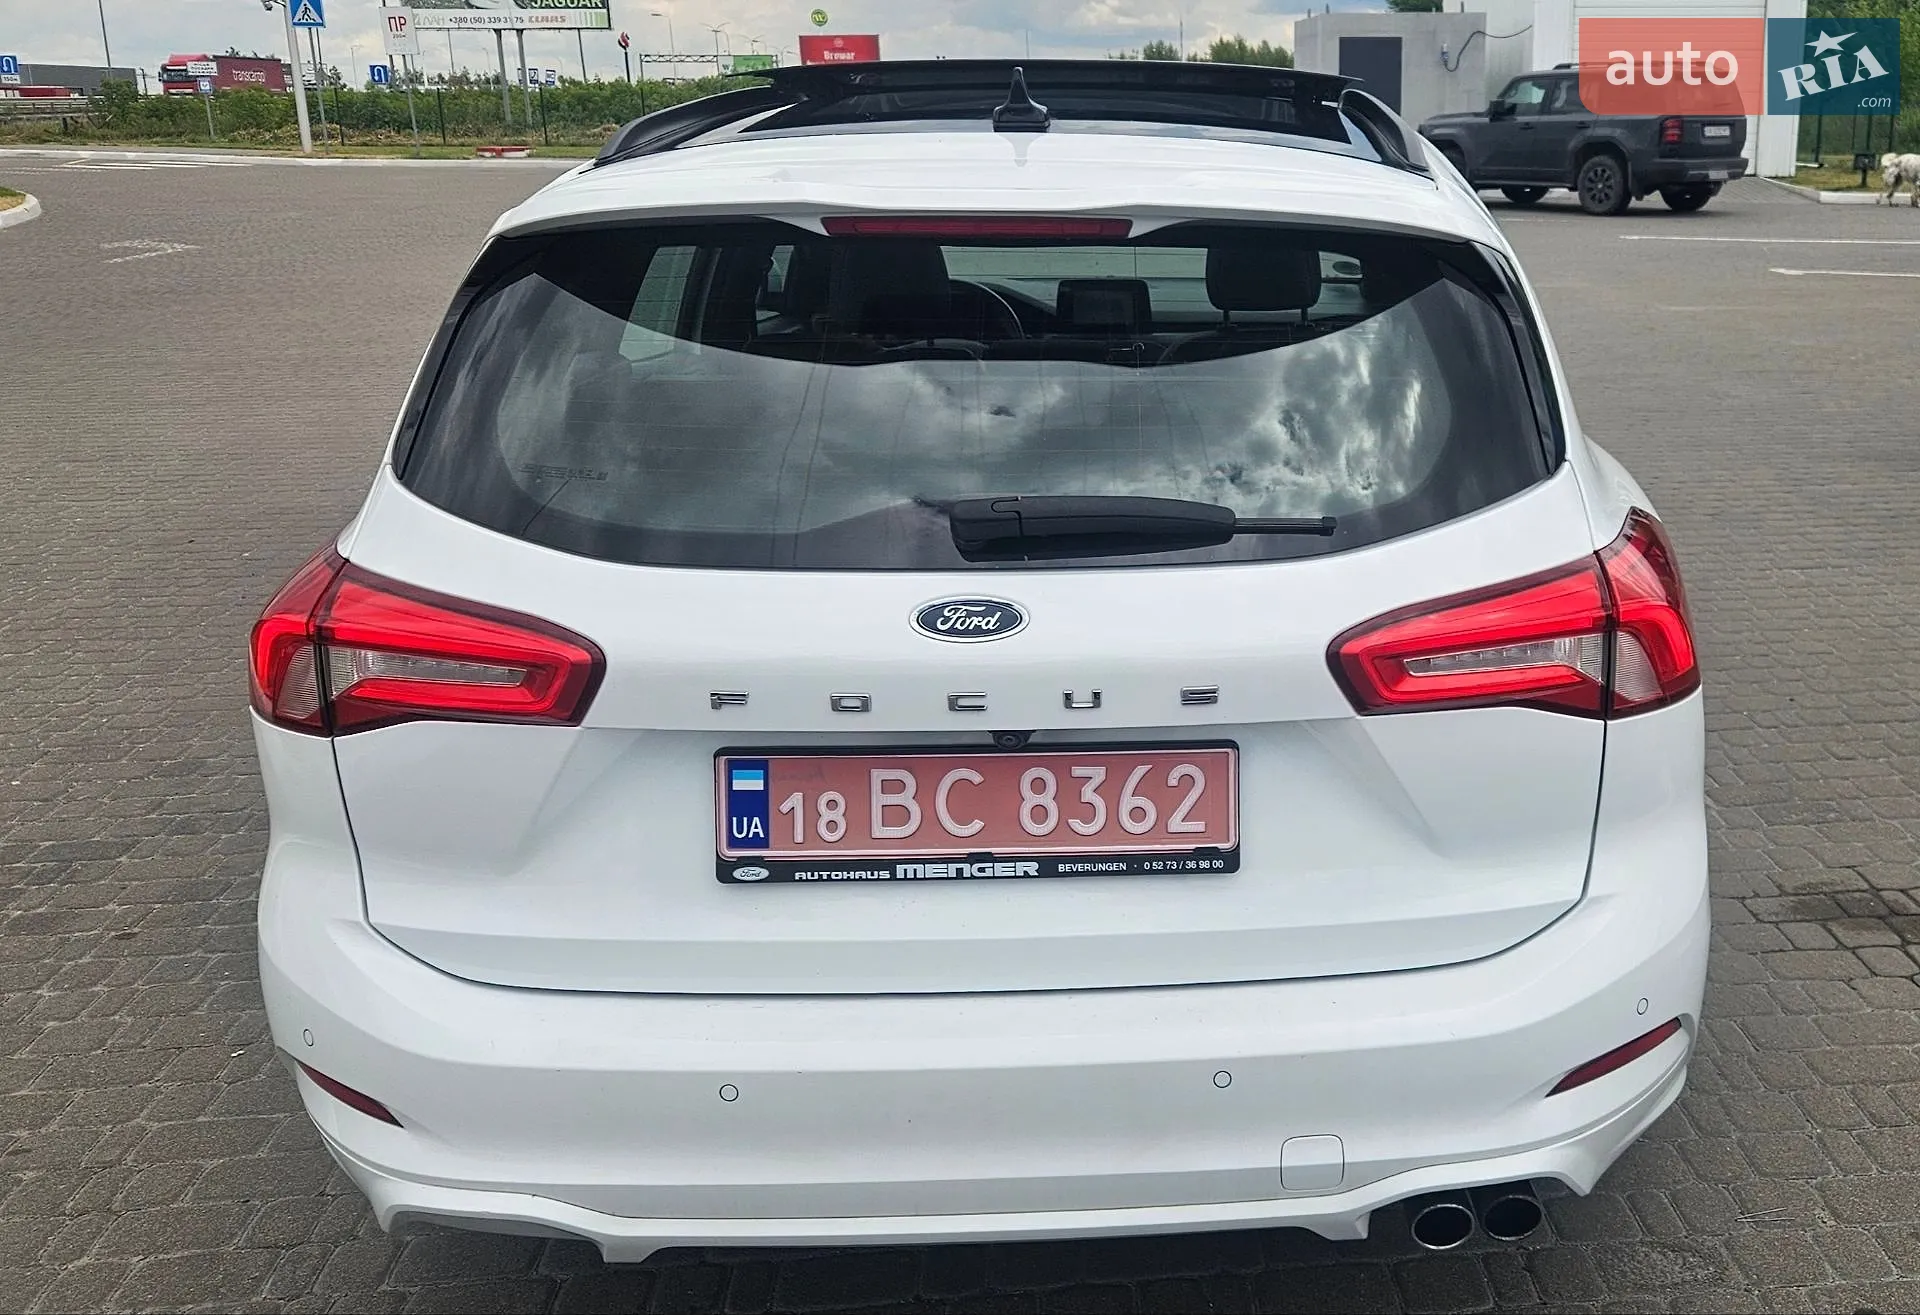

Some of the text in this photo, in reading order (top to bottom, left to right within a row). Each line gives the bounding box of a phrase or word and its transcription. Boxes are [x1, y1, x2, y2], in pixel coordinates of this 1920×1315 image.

[387, 16, 407, 32] ПР
[470, 16, 486, 24] (50)
[487, 16, 501, 24] 339
[936, 604, 1002, 632] Ford
[709, 684, 1219, 712] FOCUS
[778, 763, 1207, 844] 18 BC 8362
[732, 816, 765, 838] UA
[738, 868, 763, 879] Ford
[794, 870, 891, 881] AUTOHAUS
[895, 861, 1040, 879] MENGER
[1057, 862, 1128, 873] BEVERUNGEN
[1143, 860, 1151, 870] 0
[1152, 860, 1164, 870] 52
[1165, 860, 1178, 870] 73
[1185, 859, 1198, 869] 36
[1199, 859, 1211, 869] 98
[1211, 859, 1224, 869] 00
